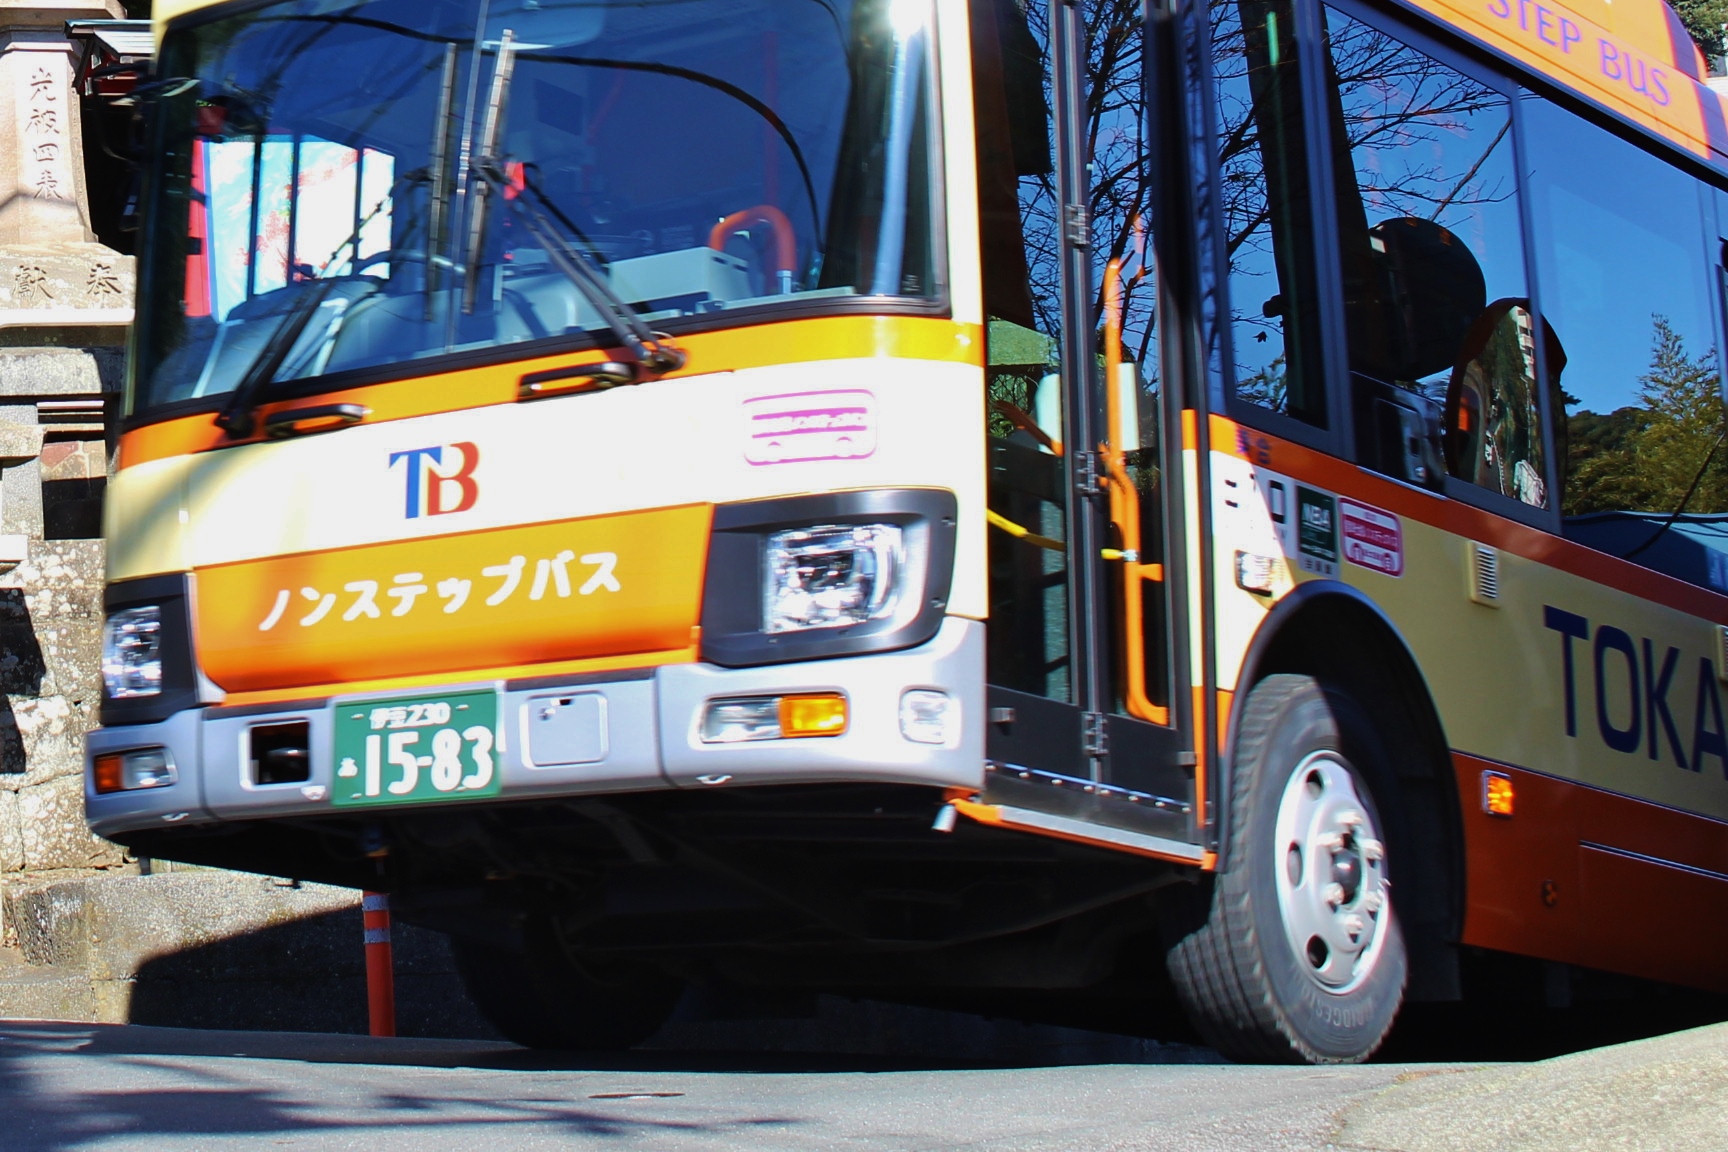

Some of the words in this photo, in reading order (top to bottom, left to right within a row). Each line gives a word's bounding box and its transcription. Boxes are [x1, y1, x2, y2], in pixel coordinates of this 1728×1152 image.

[1599, 38, 1672, 107] BUS
[388, 441, 480, 519] TB
[259, 549, 621, 631] ノンステップバス
[1543, 604, 1728, 781] TOKA
[365, 725, 494, 797] 15-83
